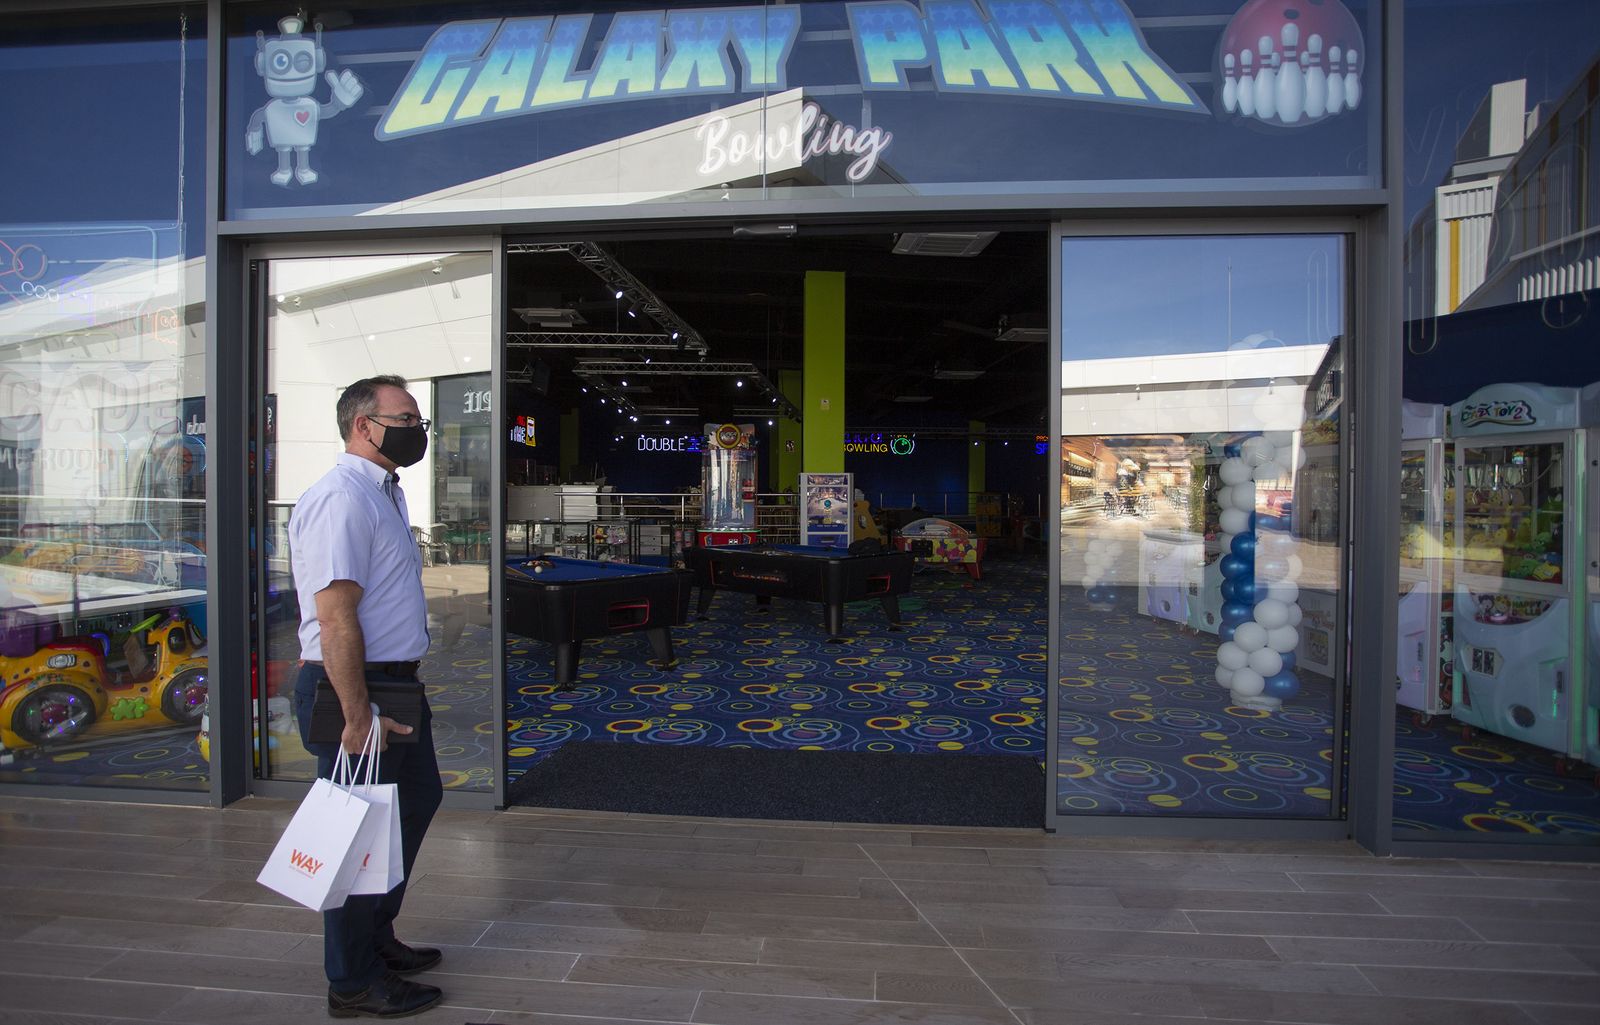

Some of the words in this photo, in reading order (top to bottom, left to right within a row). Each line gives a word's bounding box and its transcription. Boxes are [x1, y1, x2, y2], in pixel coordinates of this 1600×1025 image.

[379, 6, 801, 139] GALAXY
[848, 0, 1206, 112] PARK
[695, 102, 893, 180] Bowling
[637, 437, 686, 451] DOUBLE
[290, 849, 324, 875] WAY
